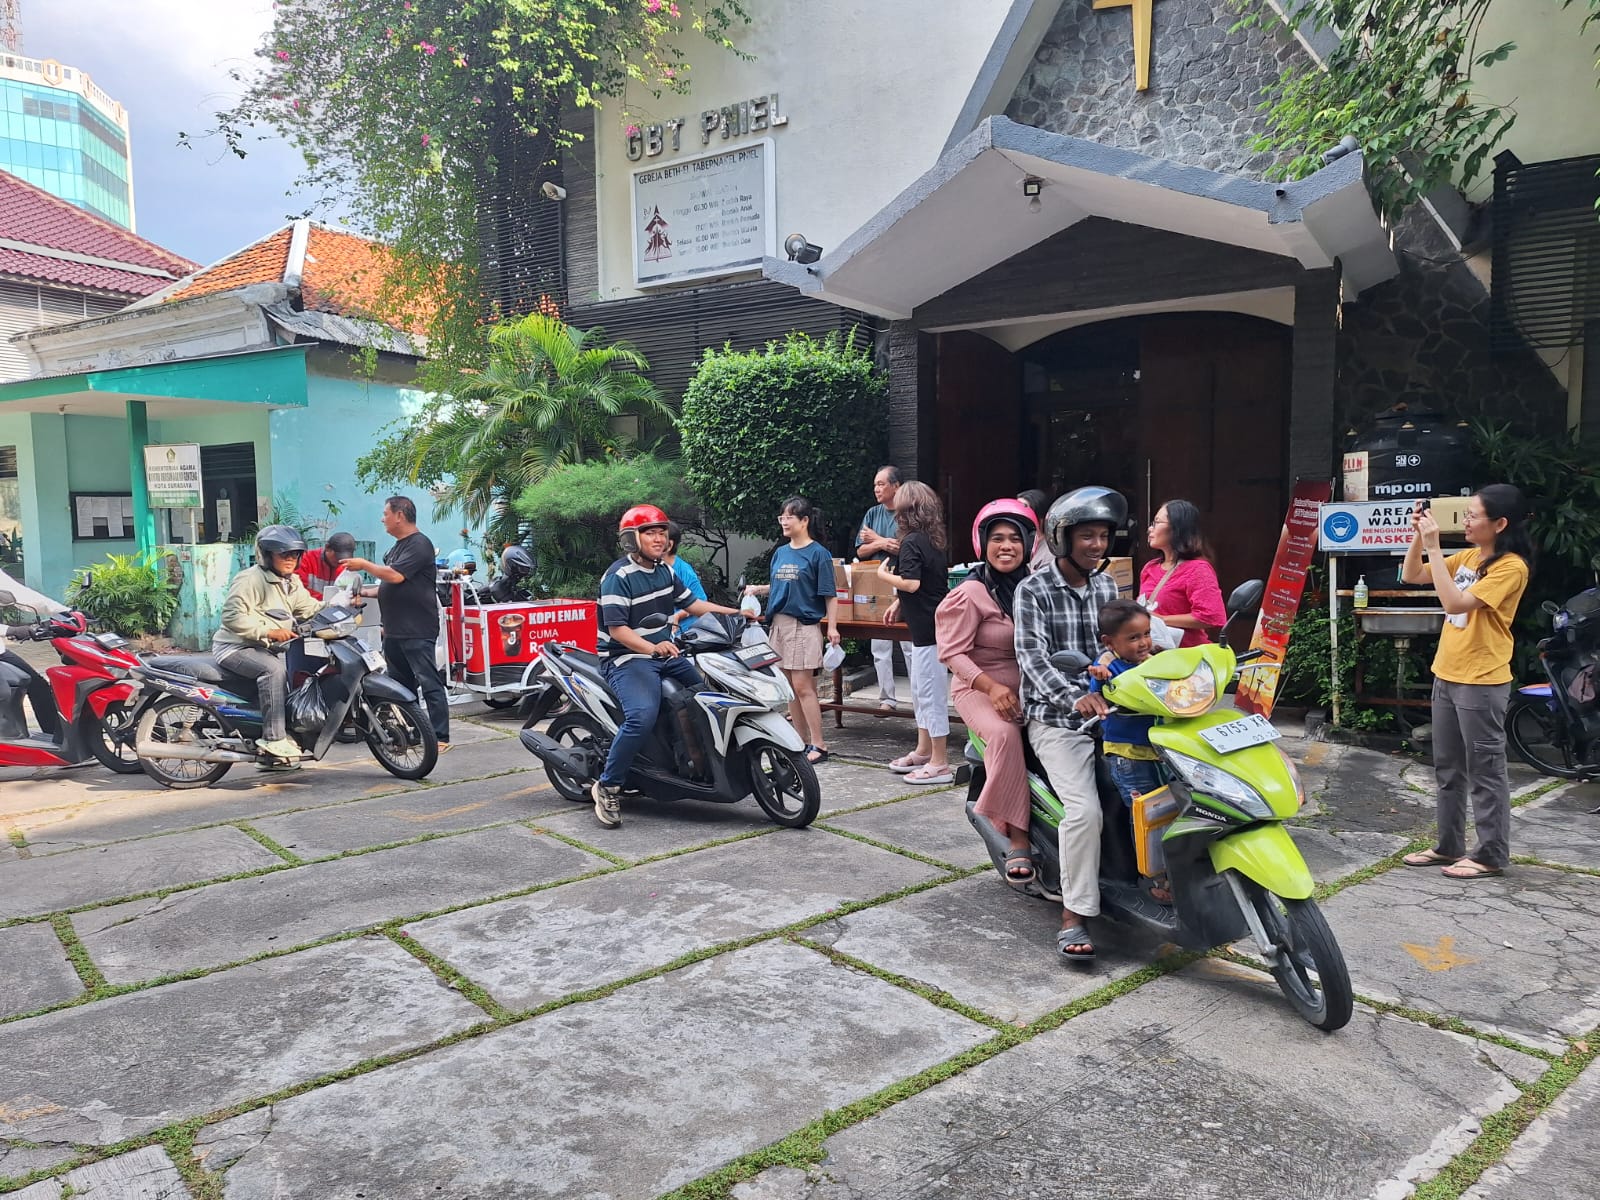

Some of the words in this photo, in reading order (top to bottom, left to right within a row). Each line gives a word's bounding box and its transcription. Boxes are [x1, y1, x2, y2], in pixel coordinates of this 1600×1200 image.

[626, 117, 685, 161] GBT
[701, 93, 788, 144] PNIEL
[638, 172, 663, 185] GEREJA
[1372, 506, 1414, 516] AREA
[1368, 516, 1408, 527] WAJI
[1361, 534, 1414, 545] MASKE
[528, 611, 556, 625] KOPI
[557, 609, 586, 622] ENAK
[529, 629, 559, 640] CUMA
[1200, 732, 1214, 742] L
[1215, 721, 1249, 737] 6755
[1195, 806, 1227, 822] HONDA
